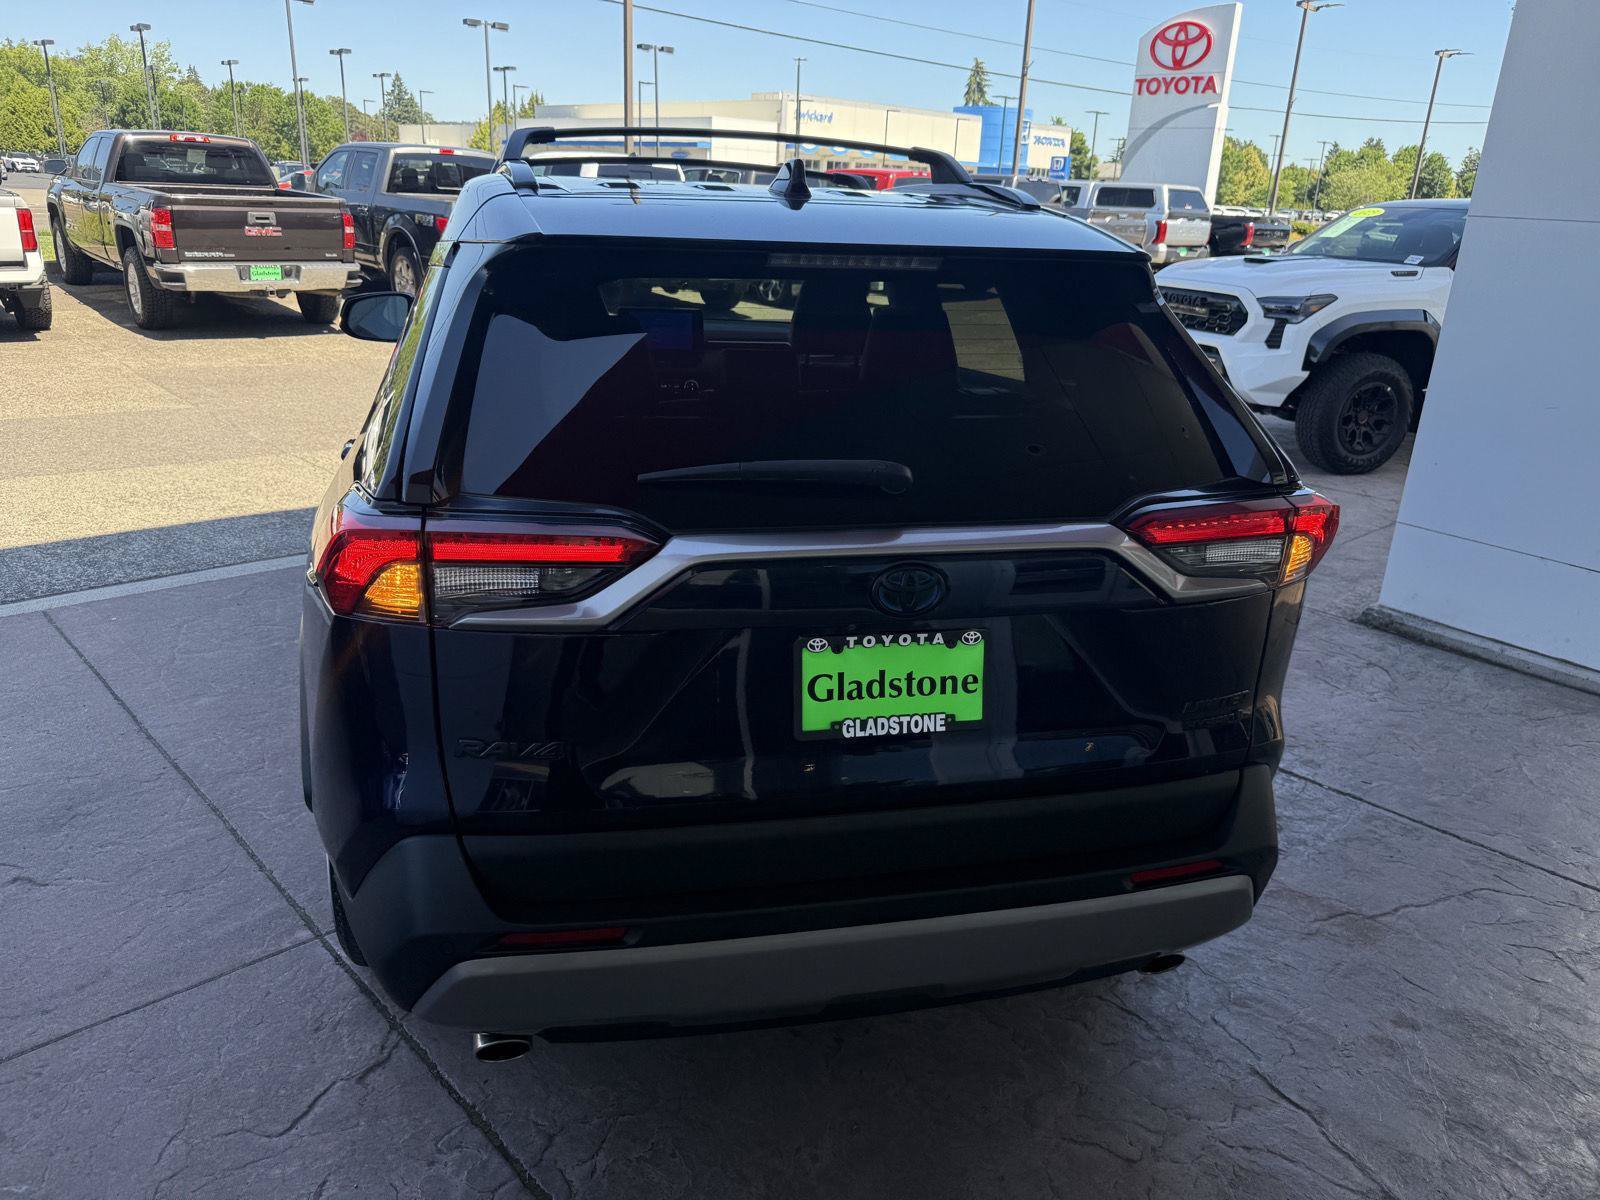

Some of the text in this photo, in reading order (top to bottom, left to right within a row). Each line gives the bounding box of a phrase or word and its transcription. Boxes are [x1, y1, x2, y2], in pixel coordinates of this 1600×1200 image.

[1136, 75, 1217, 96] TOYOTA
[244, 226, 282, 237] GMC
[846, 632, 945, 648] TOYOTA
[807, 669, 979, 702] Gladstone
[841, 713, 947, 738] GLADSTONE
